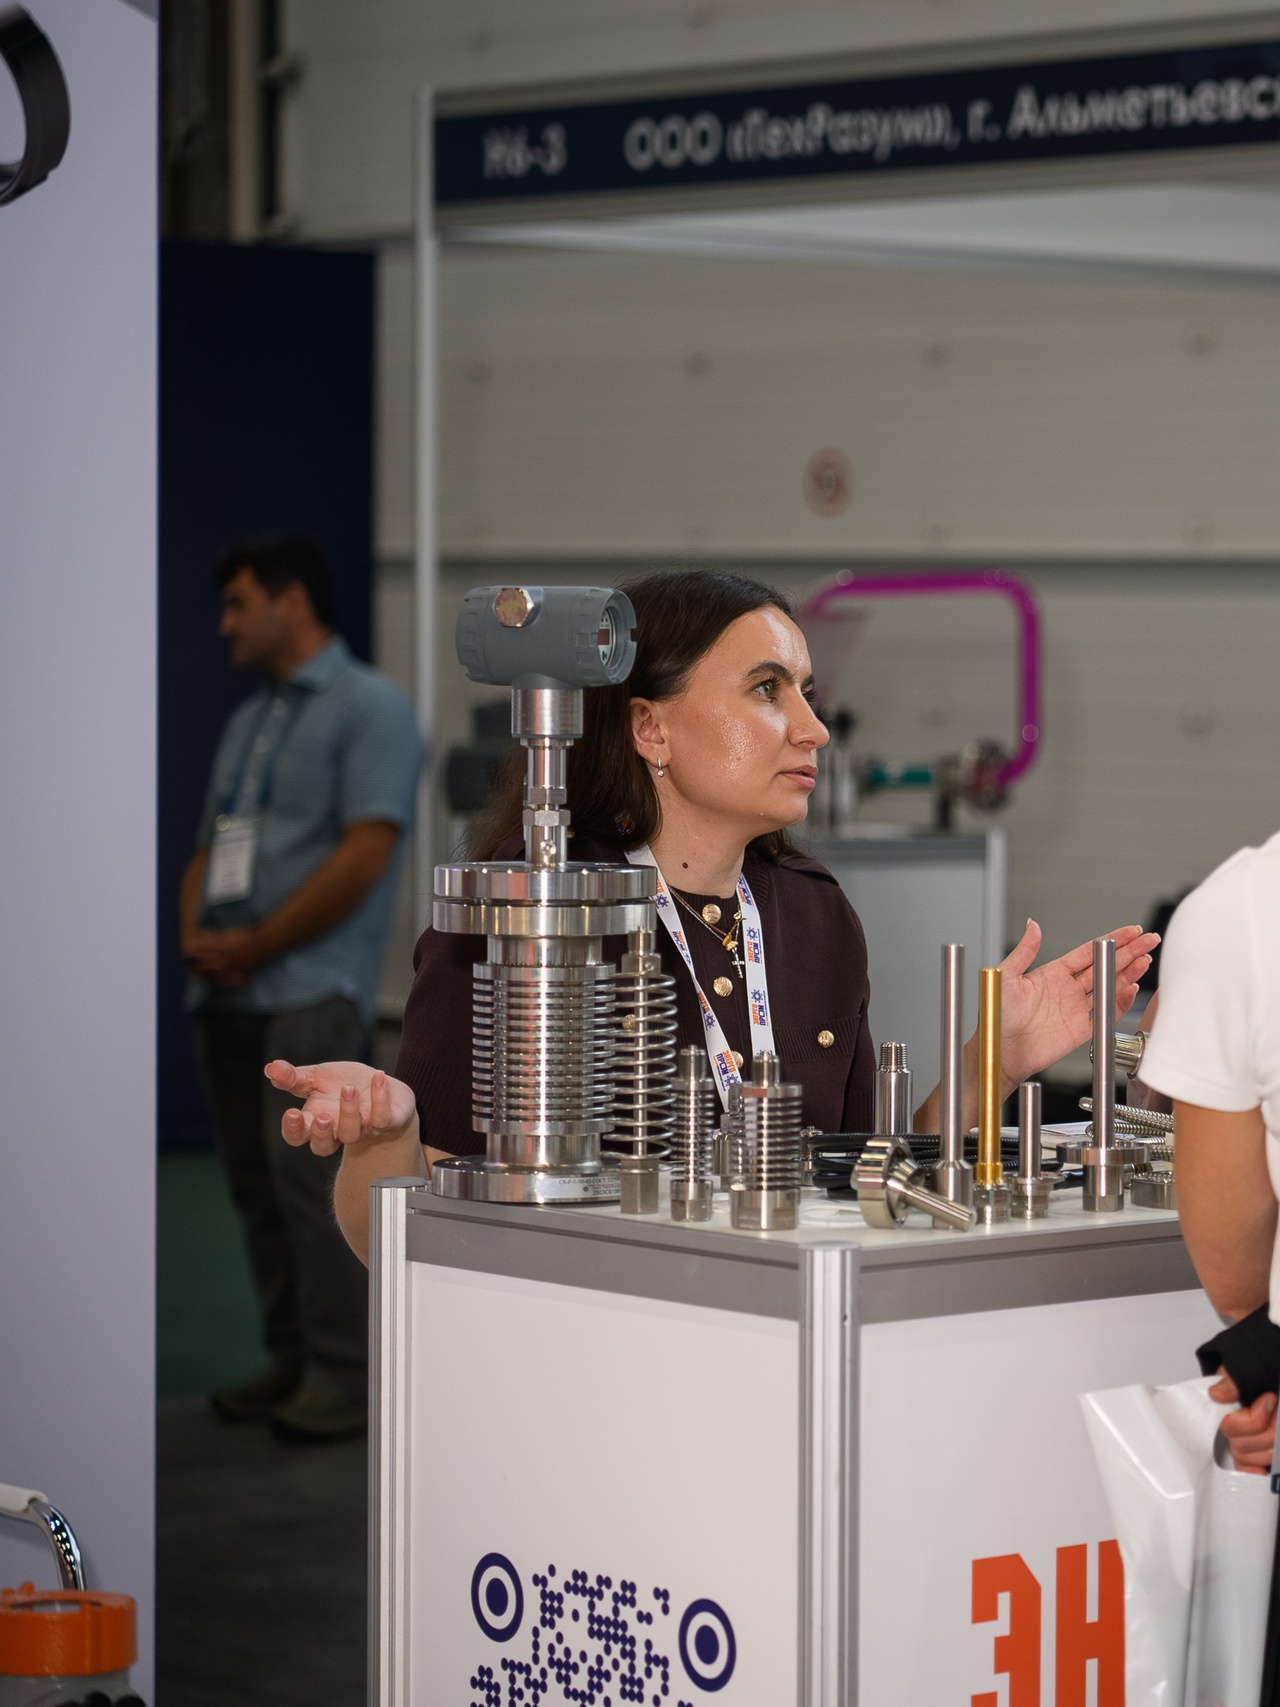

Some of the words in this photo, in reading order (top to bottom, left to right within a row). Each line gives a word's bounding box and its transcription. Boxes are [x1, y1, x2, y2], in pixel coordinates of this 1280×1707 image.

[624, 112, 723, 171] ООО
[716, 1053, 729, 1075] ПРОМ
[722, 1050, 736, 1072] ЭНЕРГО
